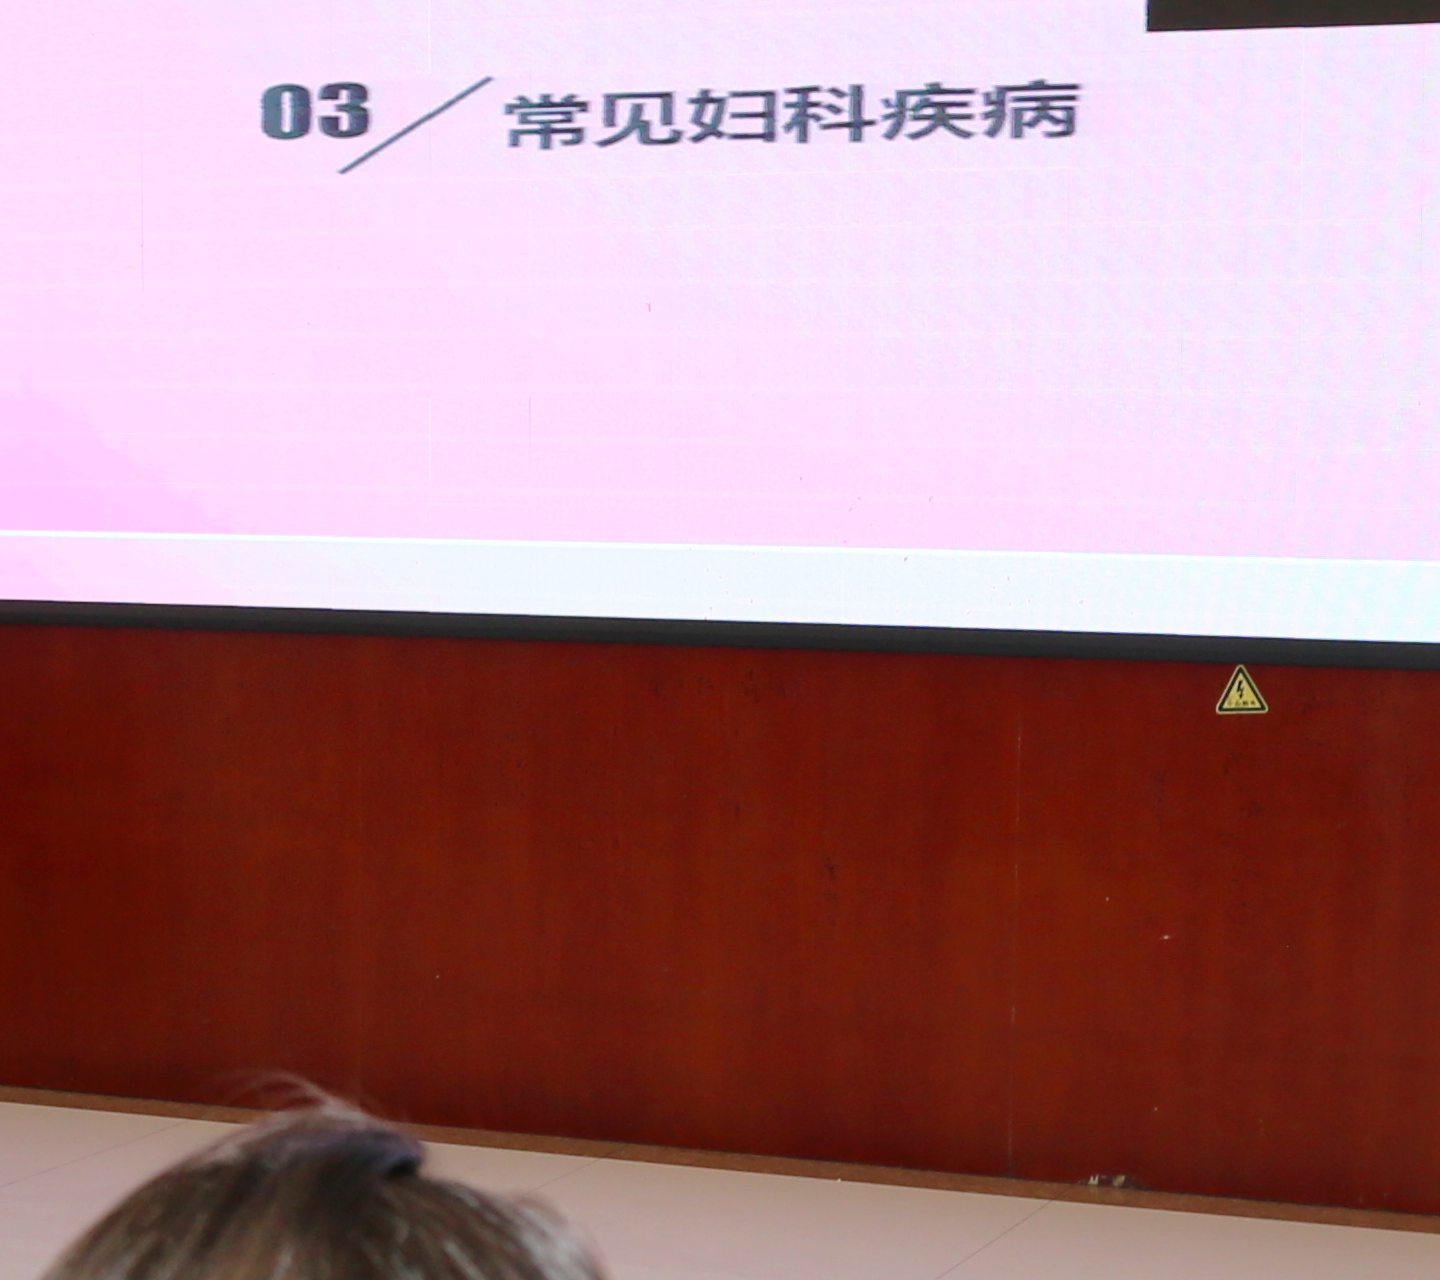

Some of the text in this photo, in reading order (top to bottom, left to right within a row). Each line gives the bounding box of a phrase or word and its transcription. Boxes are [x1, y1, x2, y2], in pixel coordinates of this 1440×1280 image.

[260, 78, 1081, 152] 03 常见妇科疾病
